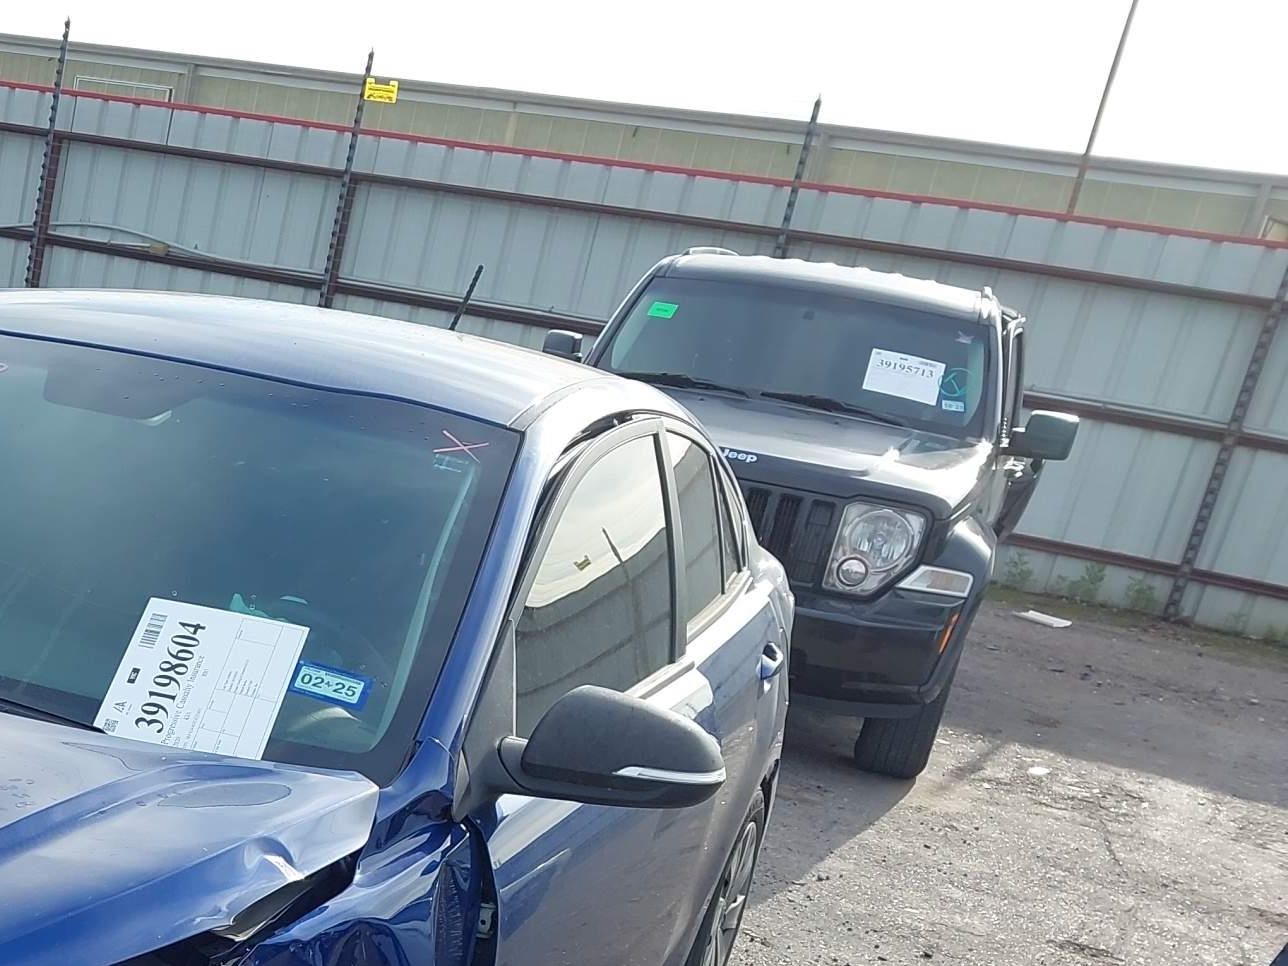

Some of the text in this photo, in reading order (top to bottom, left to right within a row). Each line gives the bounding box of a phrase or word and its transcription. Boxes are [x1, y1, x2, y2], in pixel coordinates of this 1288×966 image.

[875, 359, 935, 379] 39195713
[722, 448, 758, 463] Jeep
[134, 621, 207, 734] 39198604
